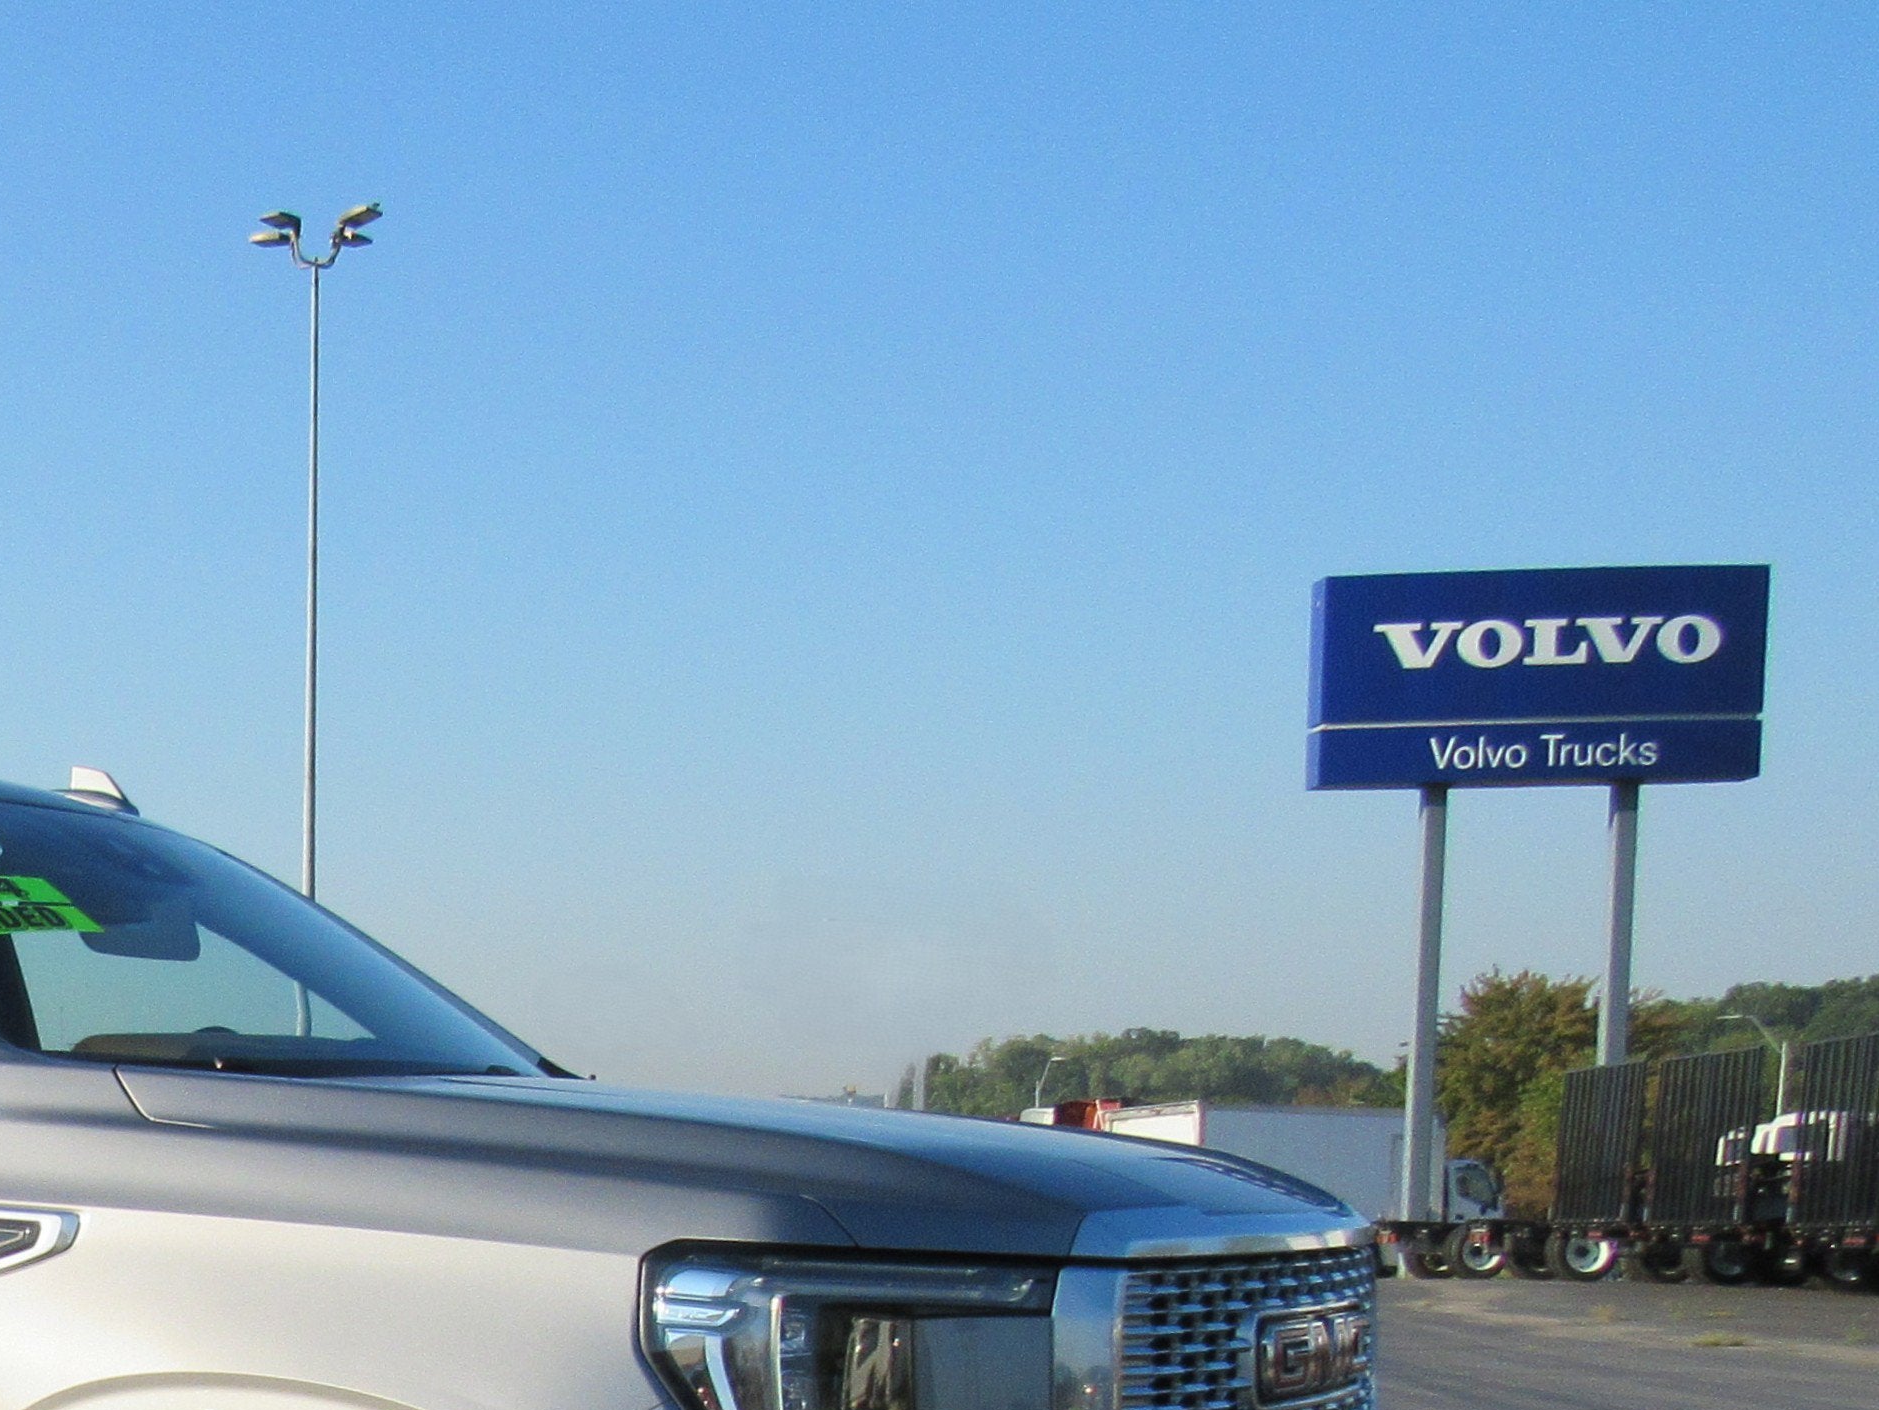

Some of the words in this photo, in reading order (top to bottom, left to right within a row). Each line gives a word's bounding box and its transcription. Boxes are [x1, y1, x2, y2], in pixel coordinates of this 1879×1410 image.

[1373, 614, 1721, 669] VOLVO
[1430, 735, 1528, 770] Volvo
[1539, 733, 1658, 768] Trucks
